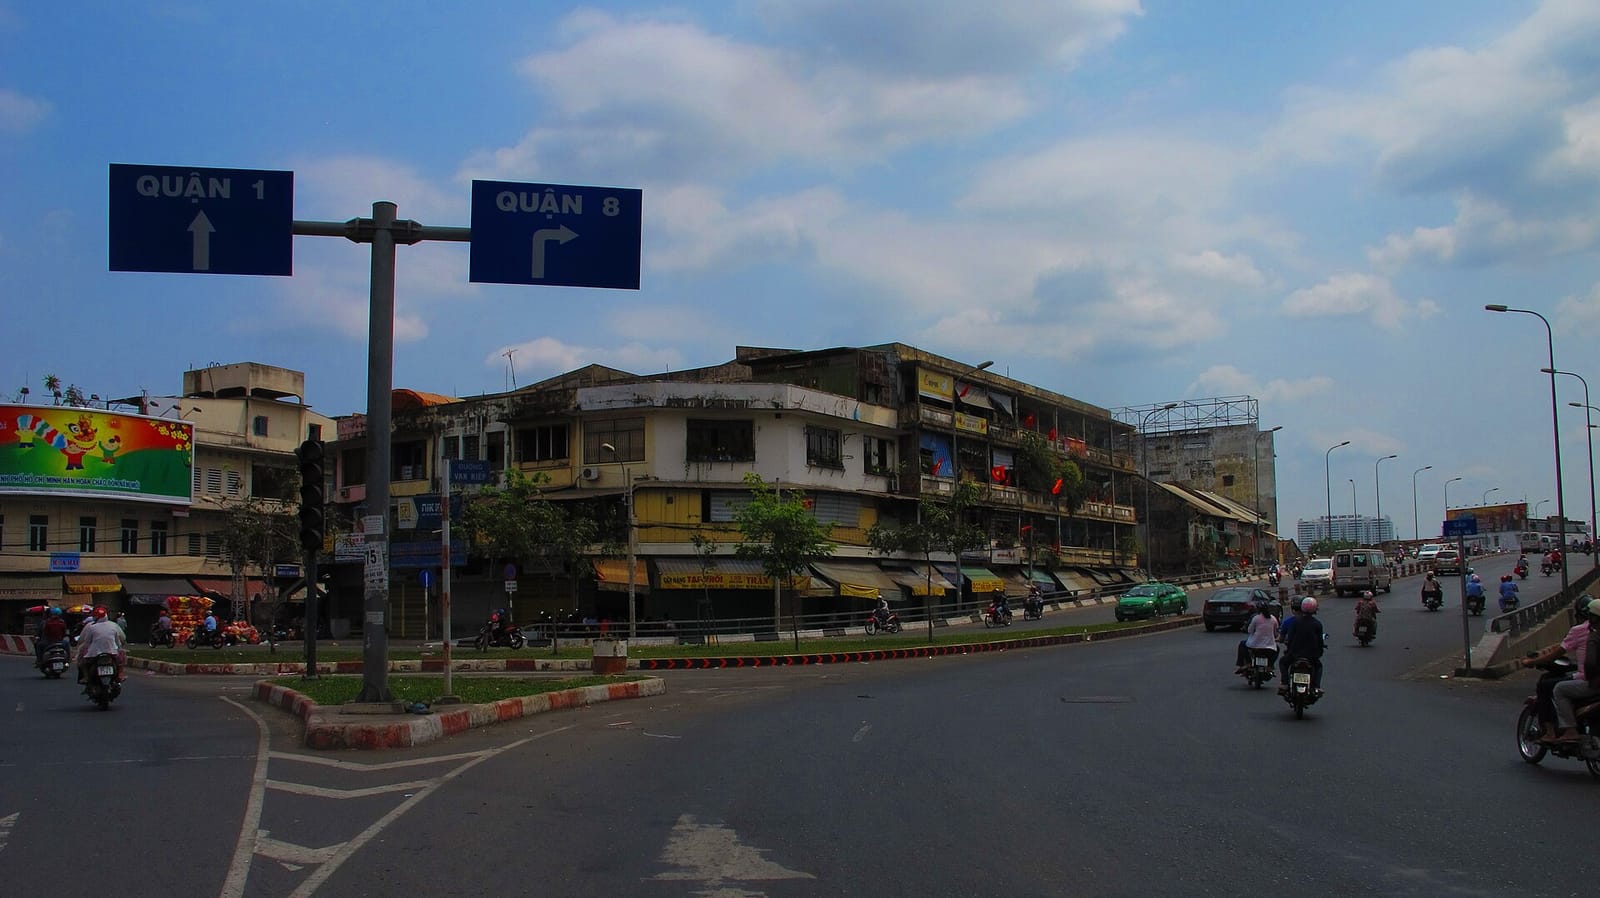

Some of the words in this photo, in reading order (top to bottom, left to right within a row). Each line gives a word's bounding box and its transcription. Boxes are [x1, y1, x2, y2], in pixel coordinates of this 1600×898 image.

[136, 172, 231, 204] QUẬN
[252, 179, 265, 200] 1
[496, 187, 582, 219] QUẬN
[602, 196, 620, 217] 8
